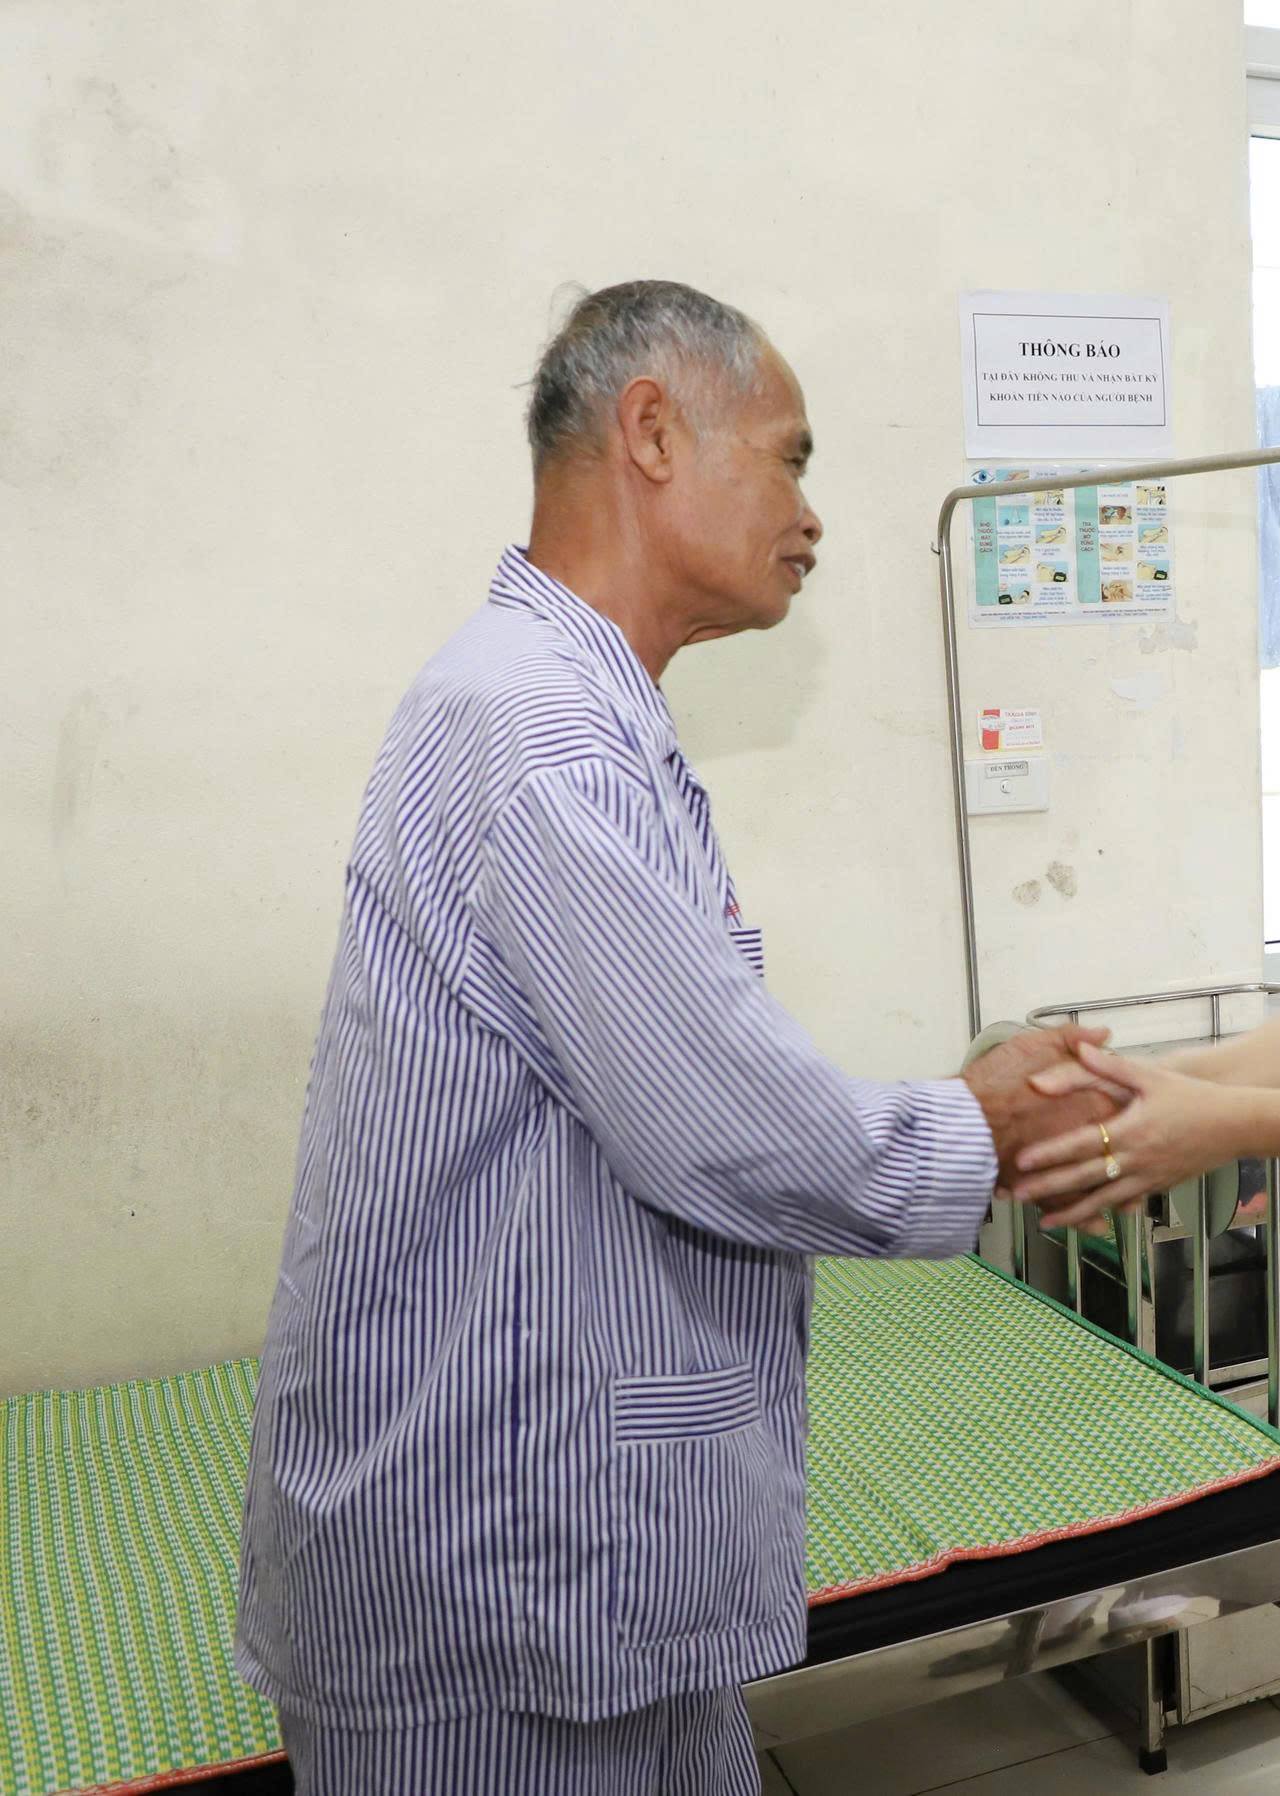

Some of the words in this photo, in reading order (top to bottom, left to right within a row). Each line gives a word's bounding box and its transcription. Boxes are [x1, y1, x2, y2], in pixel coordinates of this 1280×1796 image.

[1018, 338, 1081, 357] THÔNG
[1086, 339, 1121, 358] BÁO
[983, 372, 999, 383] TẠI
